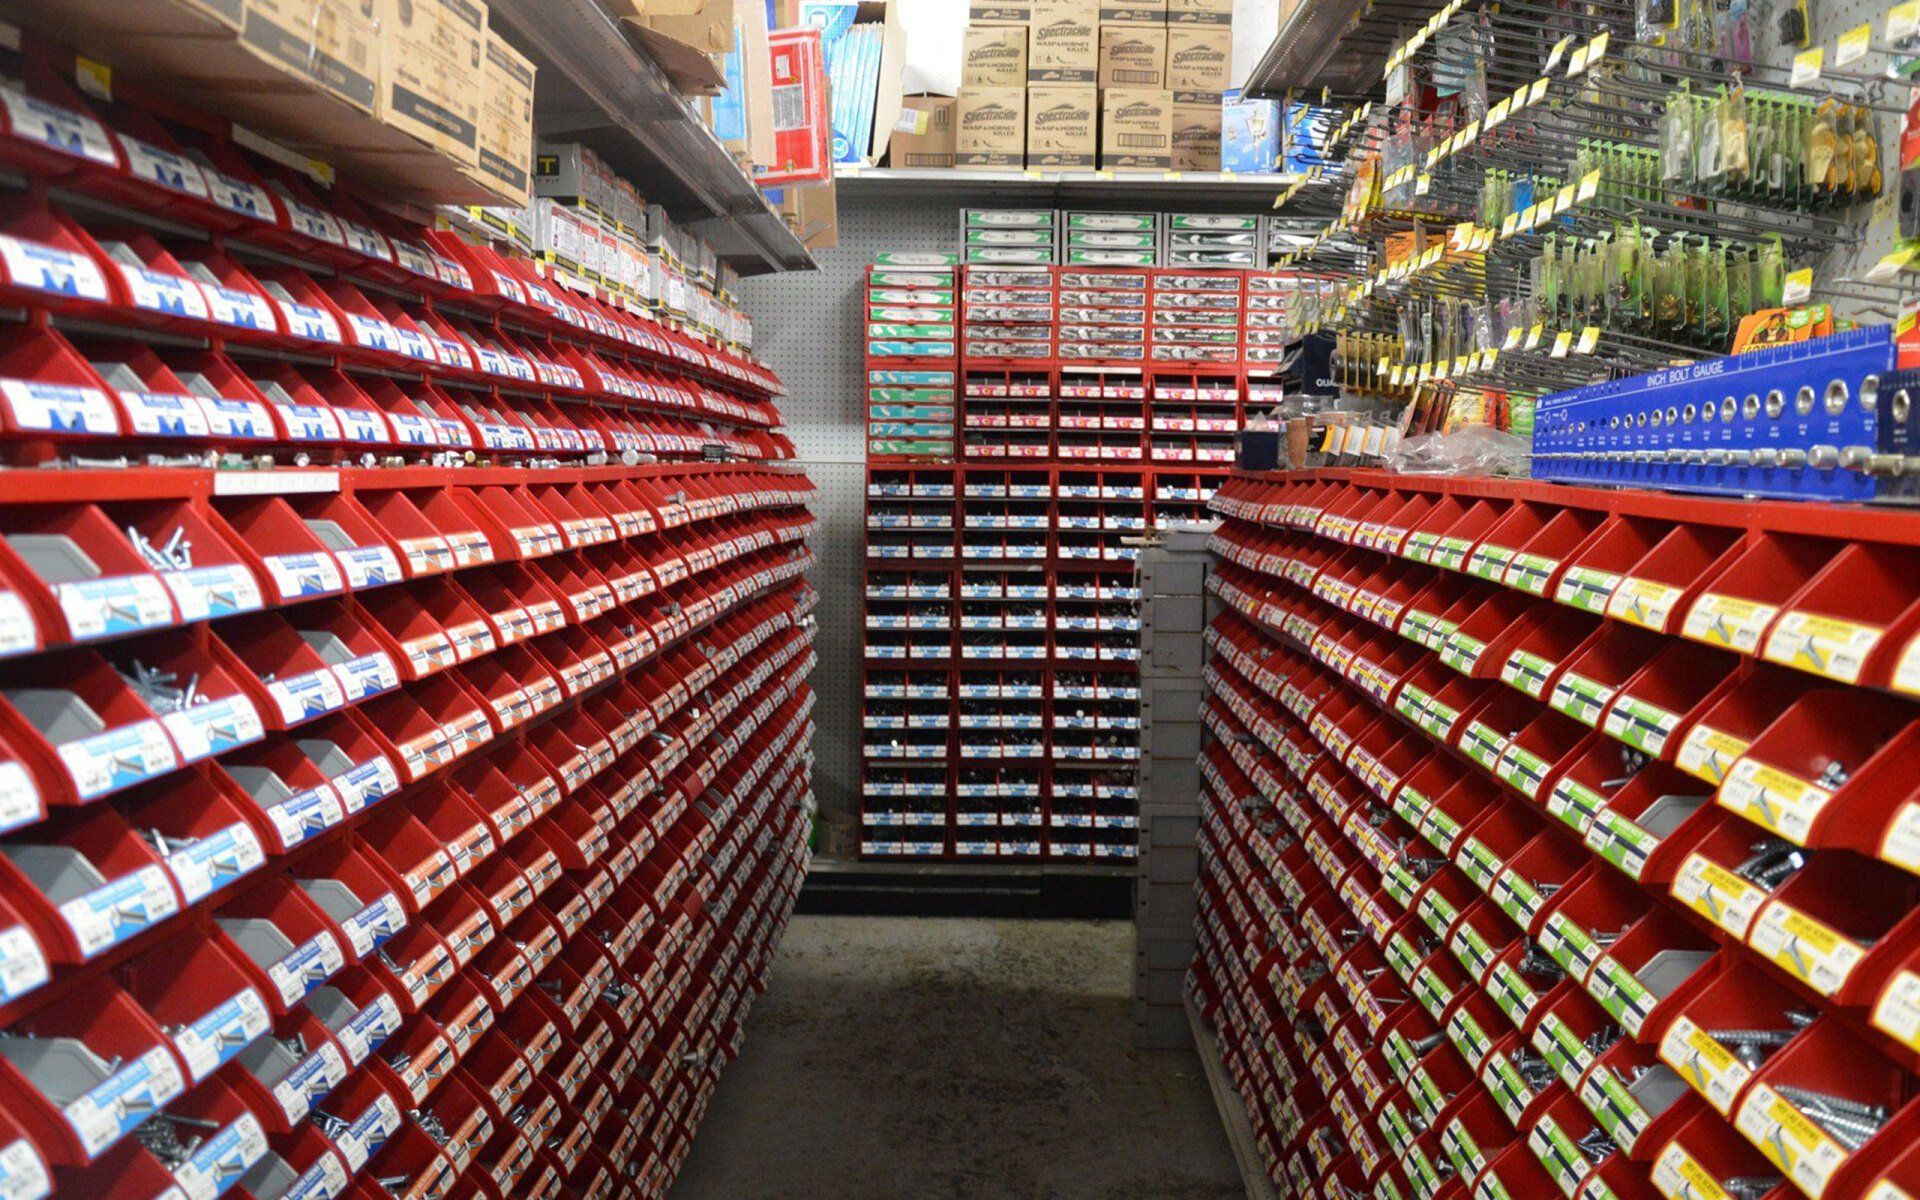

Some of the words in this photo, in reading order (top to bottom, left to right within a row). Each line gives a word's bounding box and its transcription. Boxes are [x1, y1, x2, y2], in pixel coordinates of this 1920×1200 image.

[1037, 25, 1091, 40] Spectracide
[968, 47, 1020, 62] Spectracide
[1110, 44, 1156, 55] Spectracide
[1173, 50, 1225, 63] Spectracide
[963, 109, 1017, 124] Spectracide
[1035, 110, 1090, 124] Spectracide
[1115, 107, 1162, 119] Spectracide
[1647, 372, 1666, 388] INCH
[1669, 367, 1690, 383] BOLT
[1693, 360, 1724, 378] GAUGE
